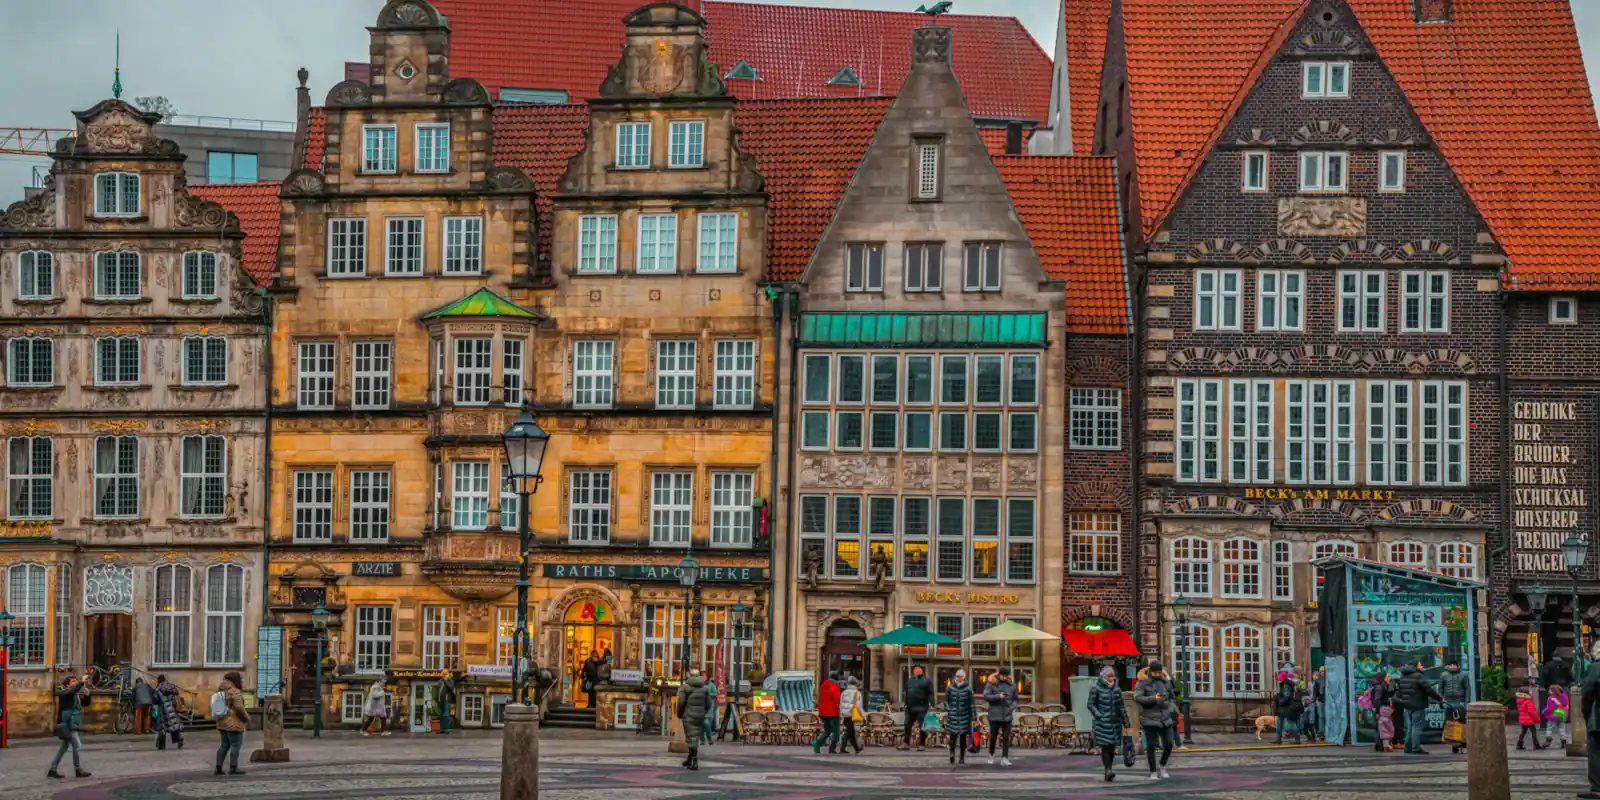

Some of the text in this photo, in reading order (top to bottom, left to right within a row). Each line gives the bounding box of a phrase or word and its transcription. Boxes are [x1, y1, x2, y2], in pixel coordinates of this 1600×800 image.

[1514, 402, 1576, 420] GEDENKE
[1514, 423, 1541, 441] DER
[1515, 466, 1567, 485] DIE DAS
[1304, 489, 1329, 500] AM
[1336, 490, 1395, 500] MARKT
[1515, 488, 1588, 506] SCHICKSAL
[1515, 510, 1578, 528] UNSERER
[555, 565, 750, 580] RATHS APOHEKE
[966, 592, 1020, 604] BISTRO
[1356, 609, 1435, 624] LICHTER
[1356, 629, 1441, 644] DER CITY
